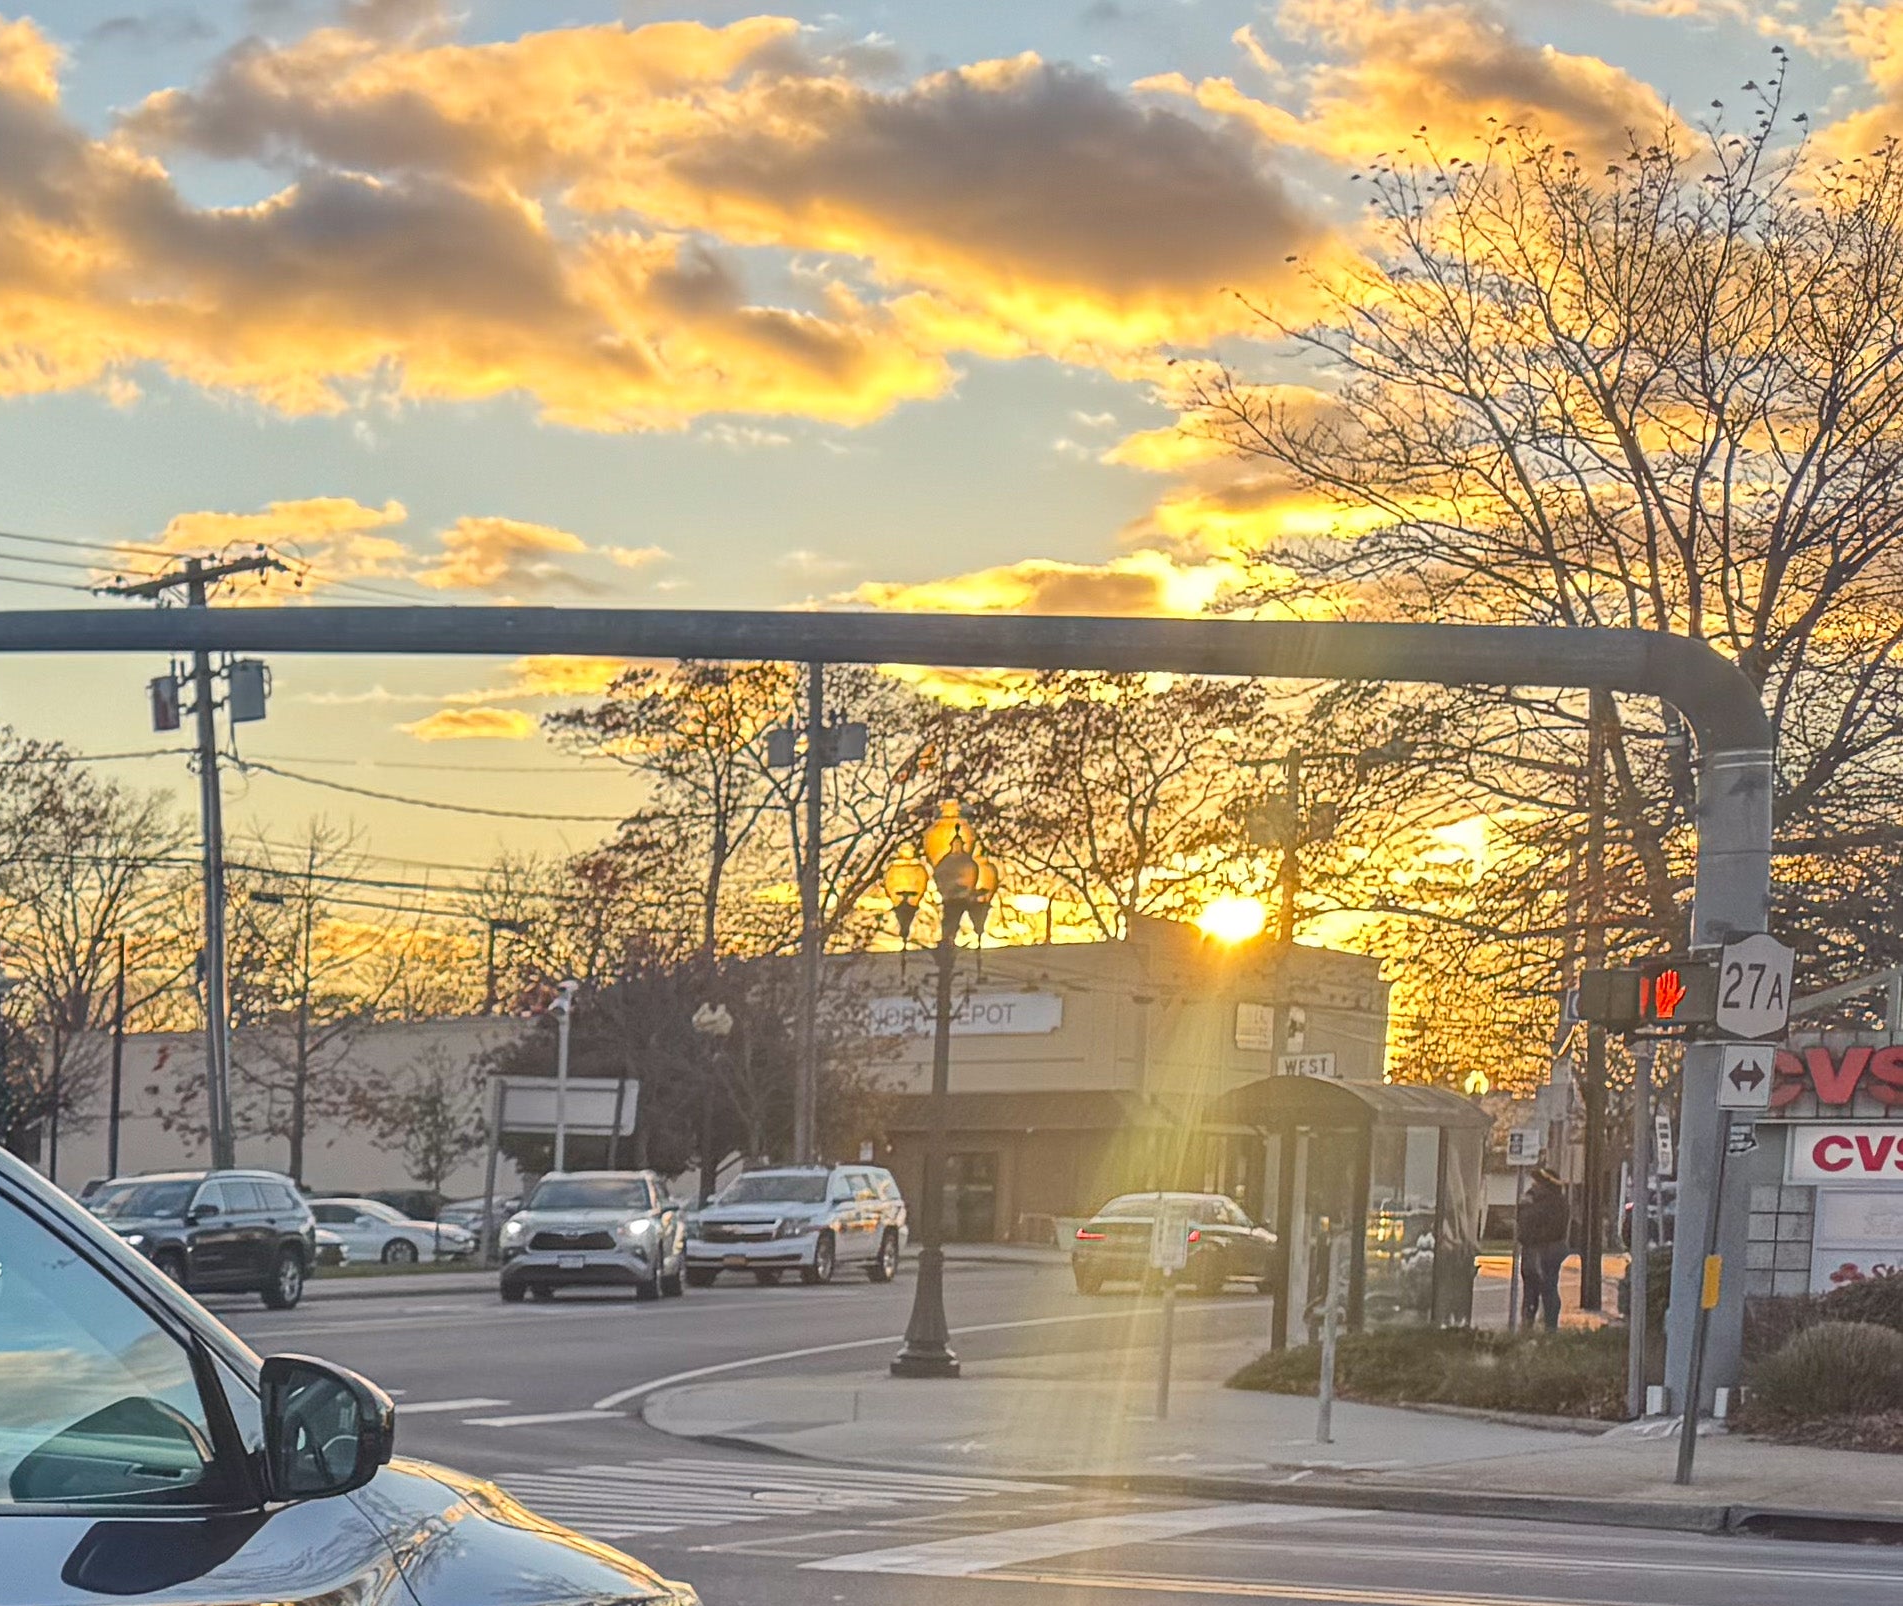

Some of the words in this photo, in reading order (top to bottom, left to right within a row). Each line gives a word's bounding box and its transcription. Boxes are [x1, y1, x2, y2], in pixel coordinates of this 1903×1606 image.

[1722, 962, 1783, 1010] 27A
[1284, 1058, 1328, 1075] WEST
[1812, 1135, 1903, 1172] CV
